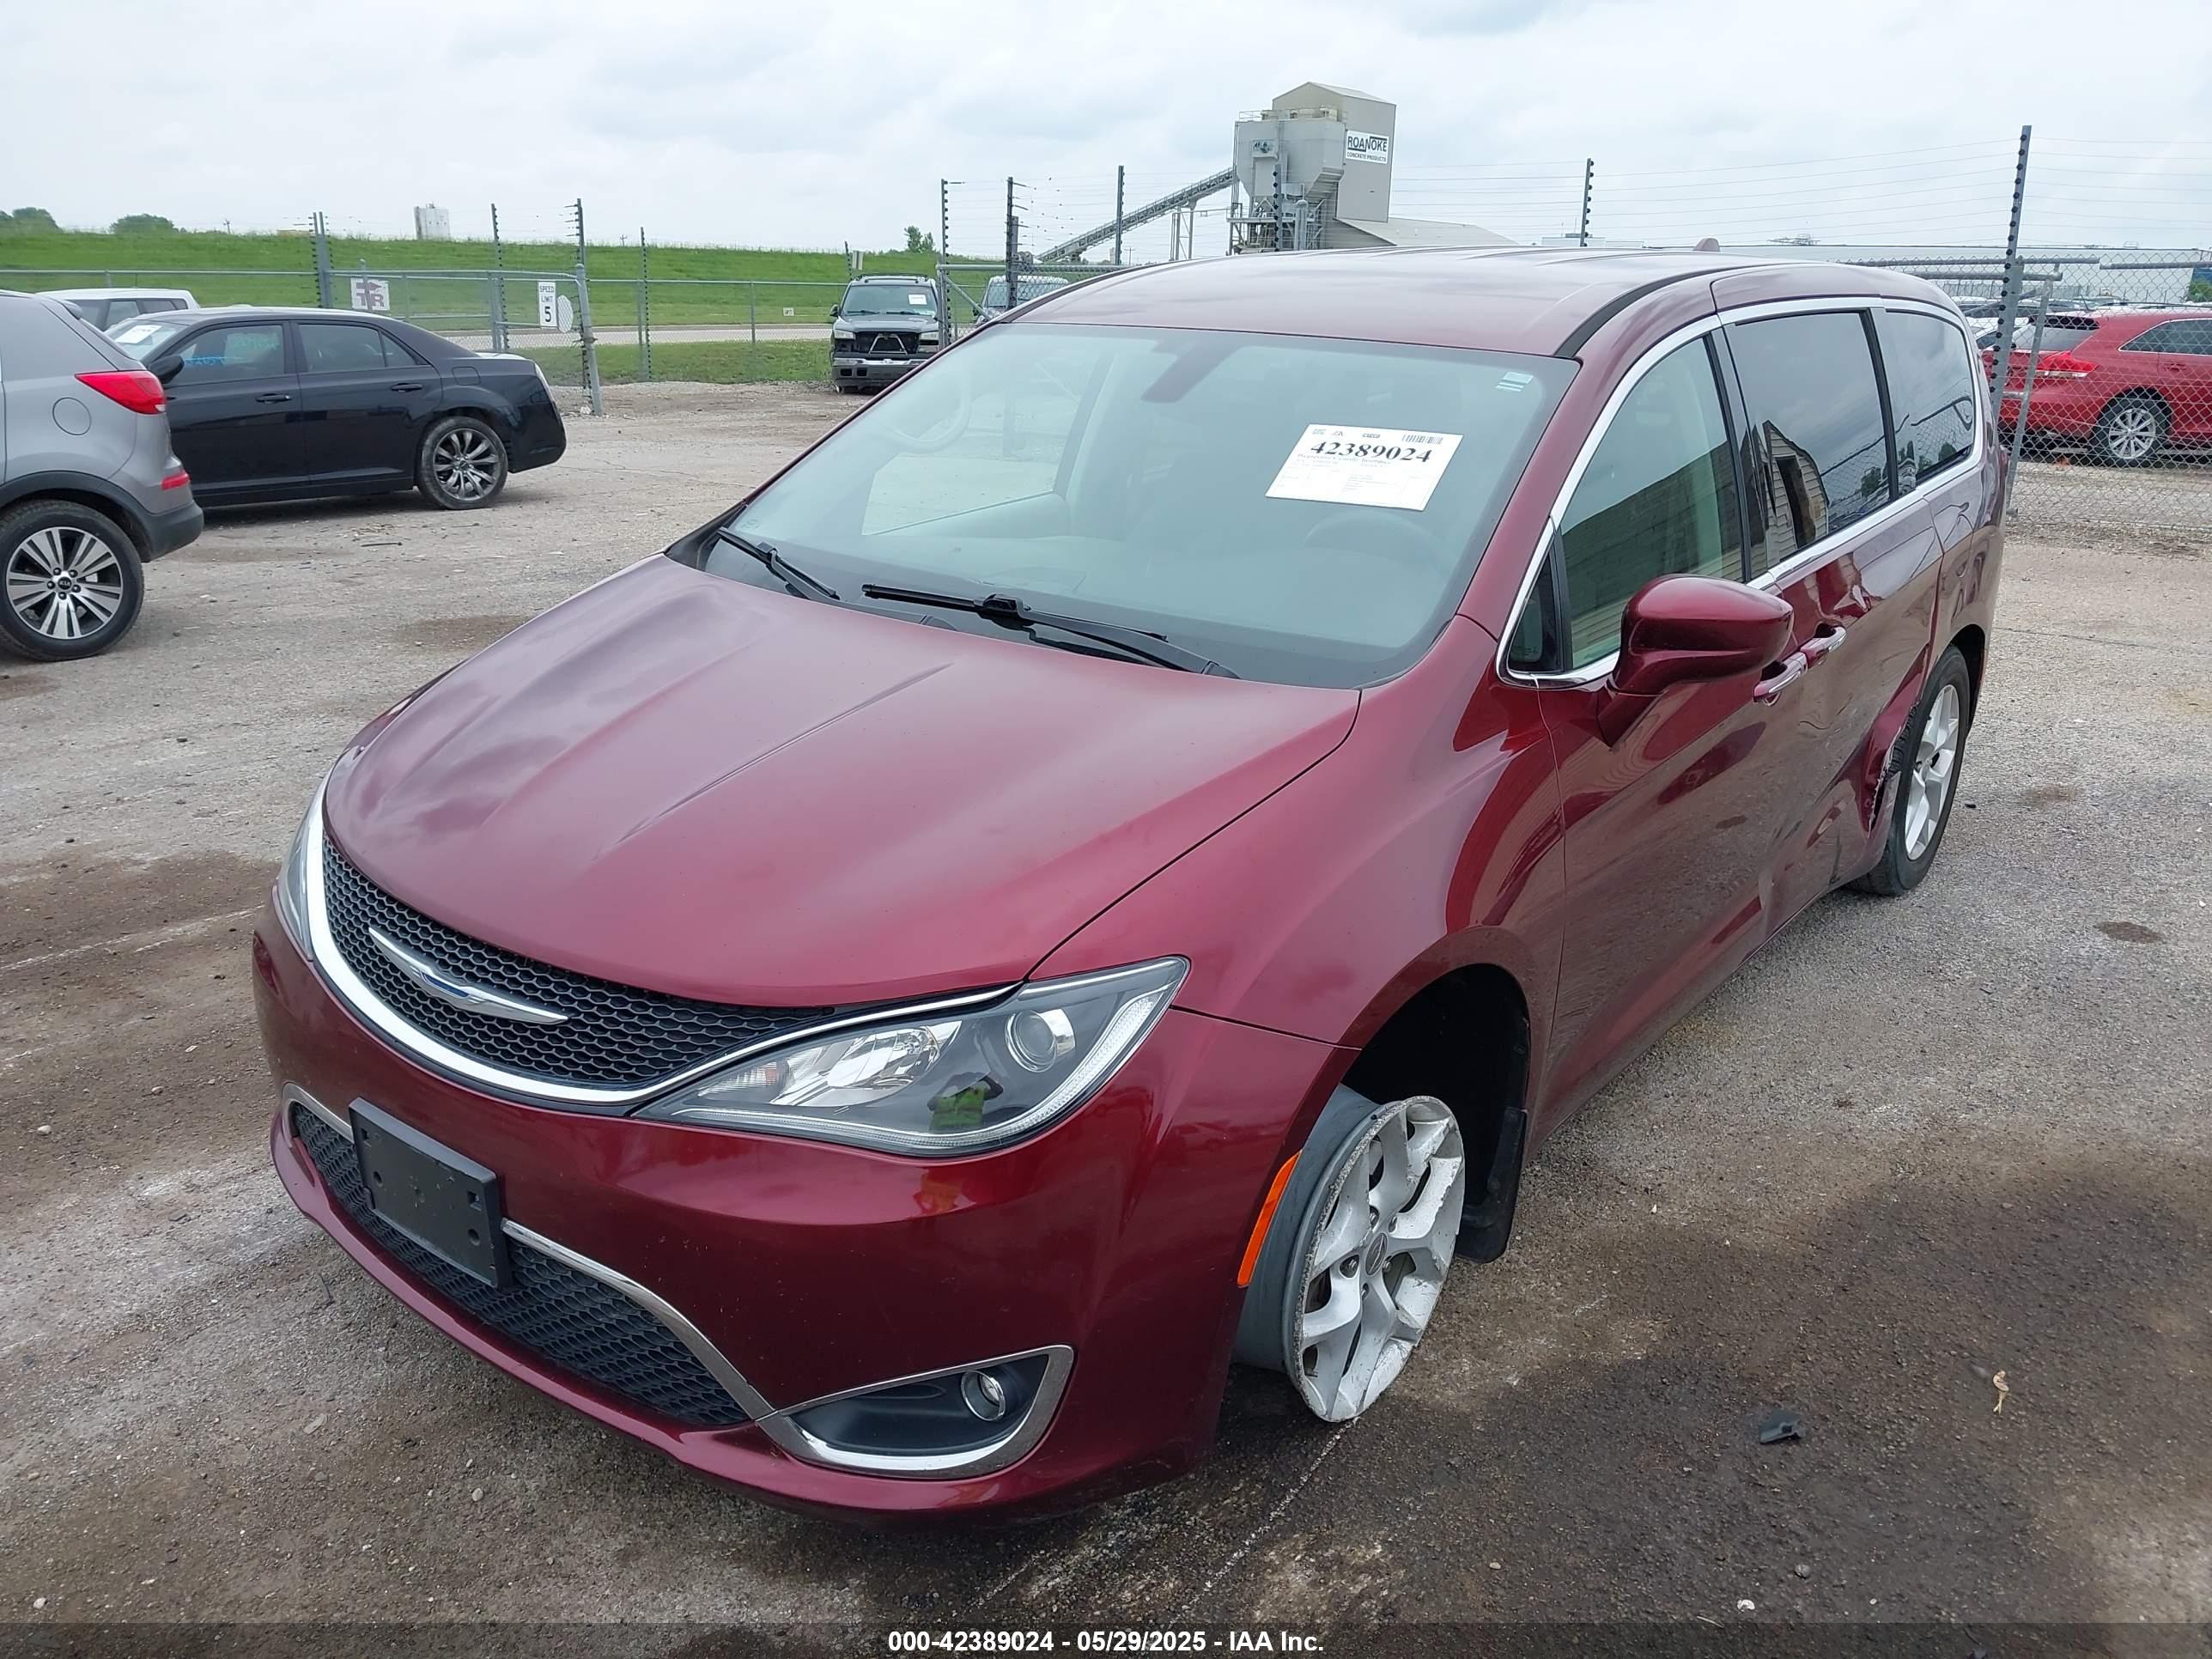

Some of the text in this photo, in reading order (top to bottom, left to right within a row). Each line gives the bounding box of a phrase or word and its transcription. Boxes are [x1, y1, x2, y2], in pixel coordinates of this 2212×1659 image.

[1348, 137, 1387, 152] ROANOKE
[544, 306, 551, 323] 5
[1310, 441, 1432, 463] 42389024
